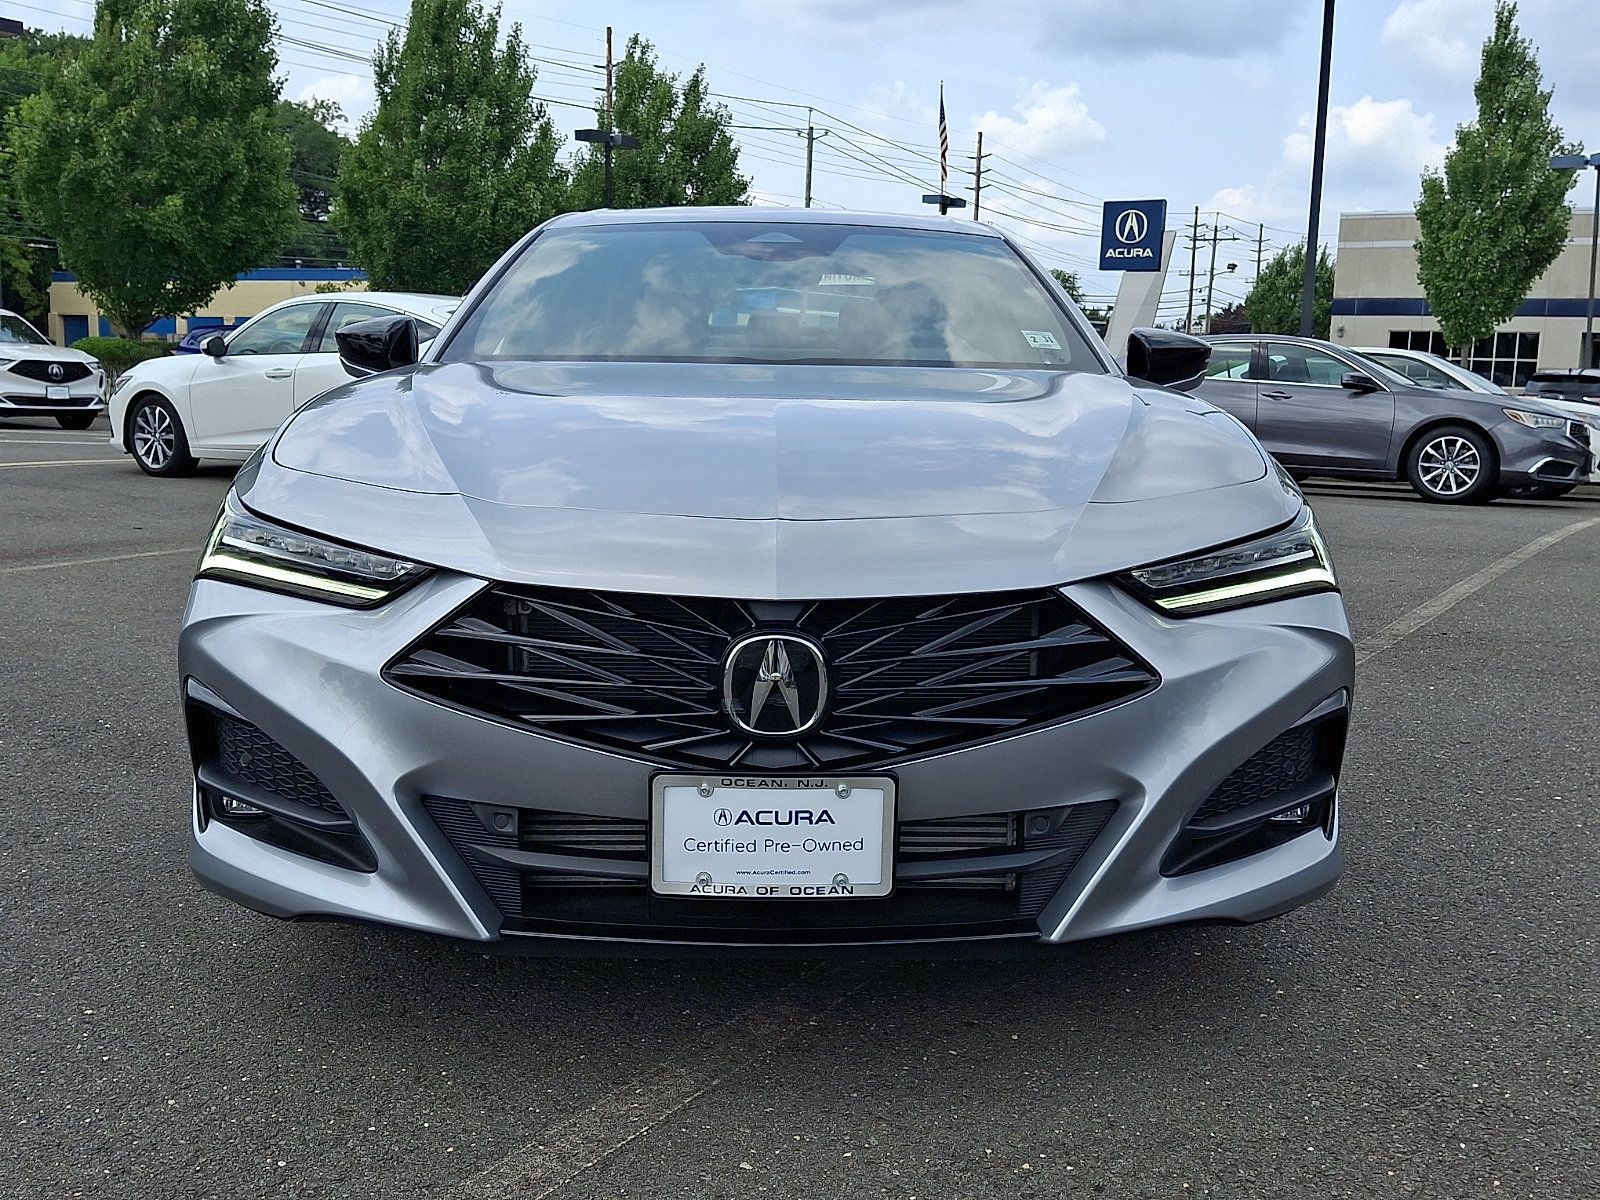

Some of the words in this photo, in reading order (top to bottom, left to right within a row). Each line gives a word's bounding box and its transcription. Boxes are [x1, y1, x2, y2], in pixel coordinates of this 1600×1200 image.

[1105, 248, 1153, 258] ACURA
[797, 779, 828, 788] N.J.
[734, 810, 836, 826] ACURA
[683, 838, 757, 852] Certified
[764, 838, 864, 852] Pre-Owned
[690, 884, 748, 895] ACURA
[756, 886, 780, 896] OF
[789, 885, 854, 895] OCEAN
